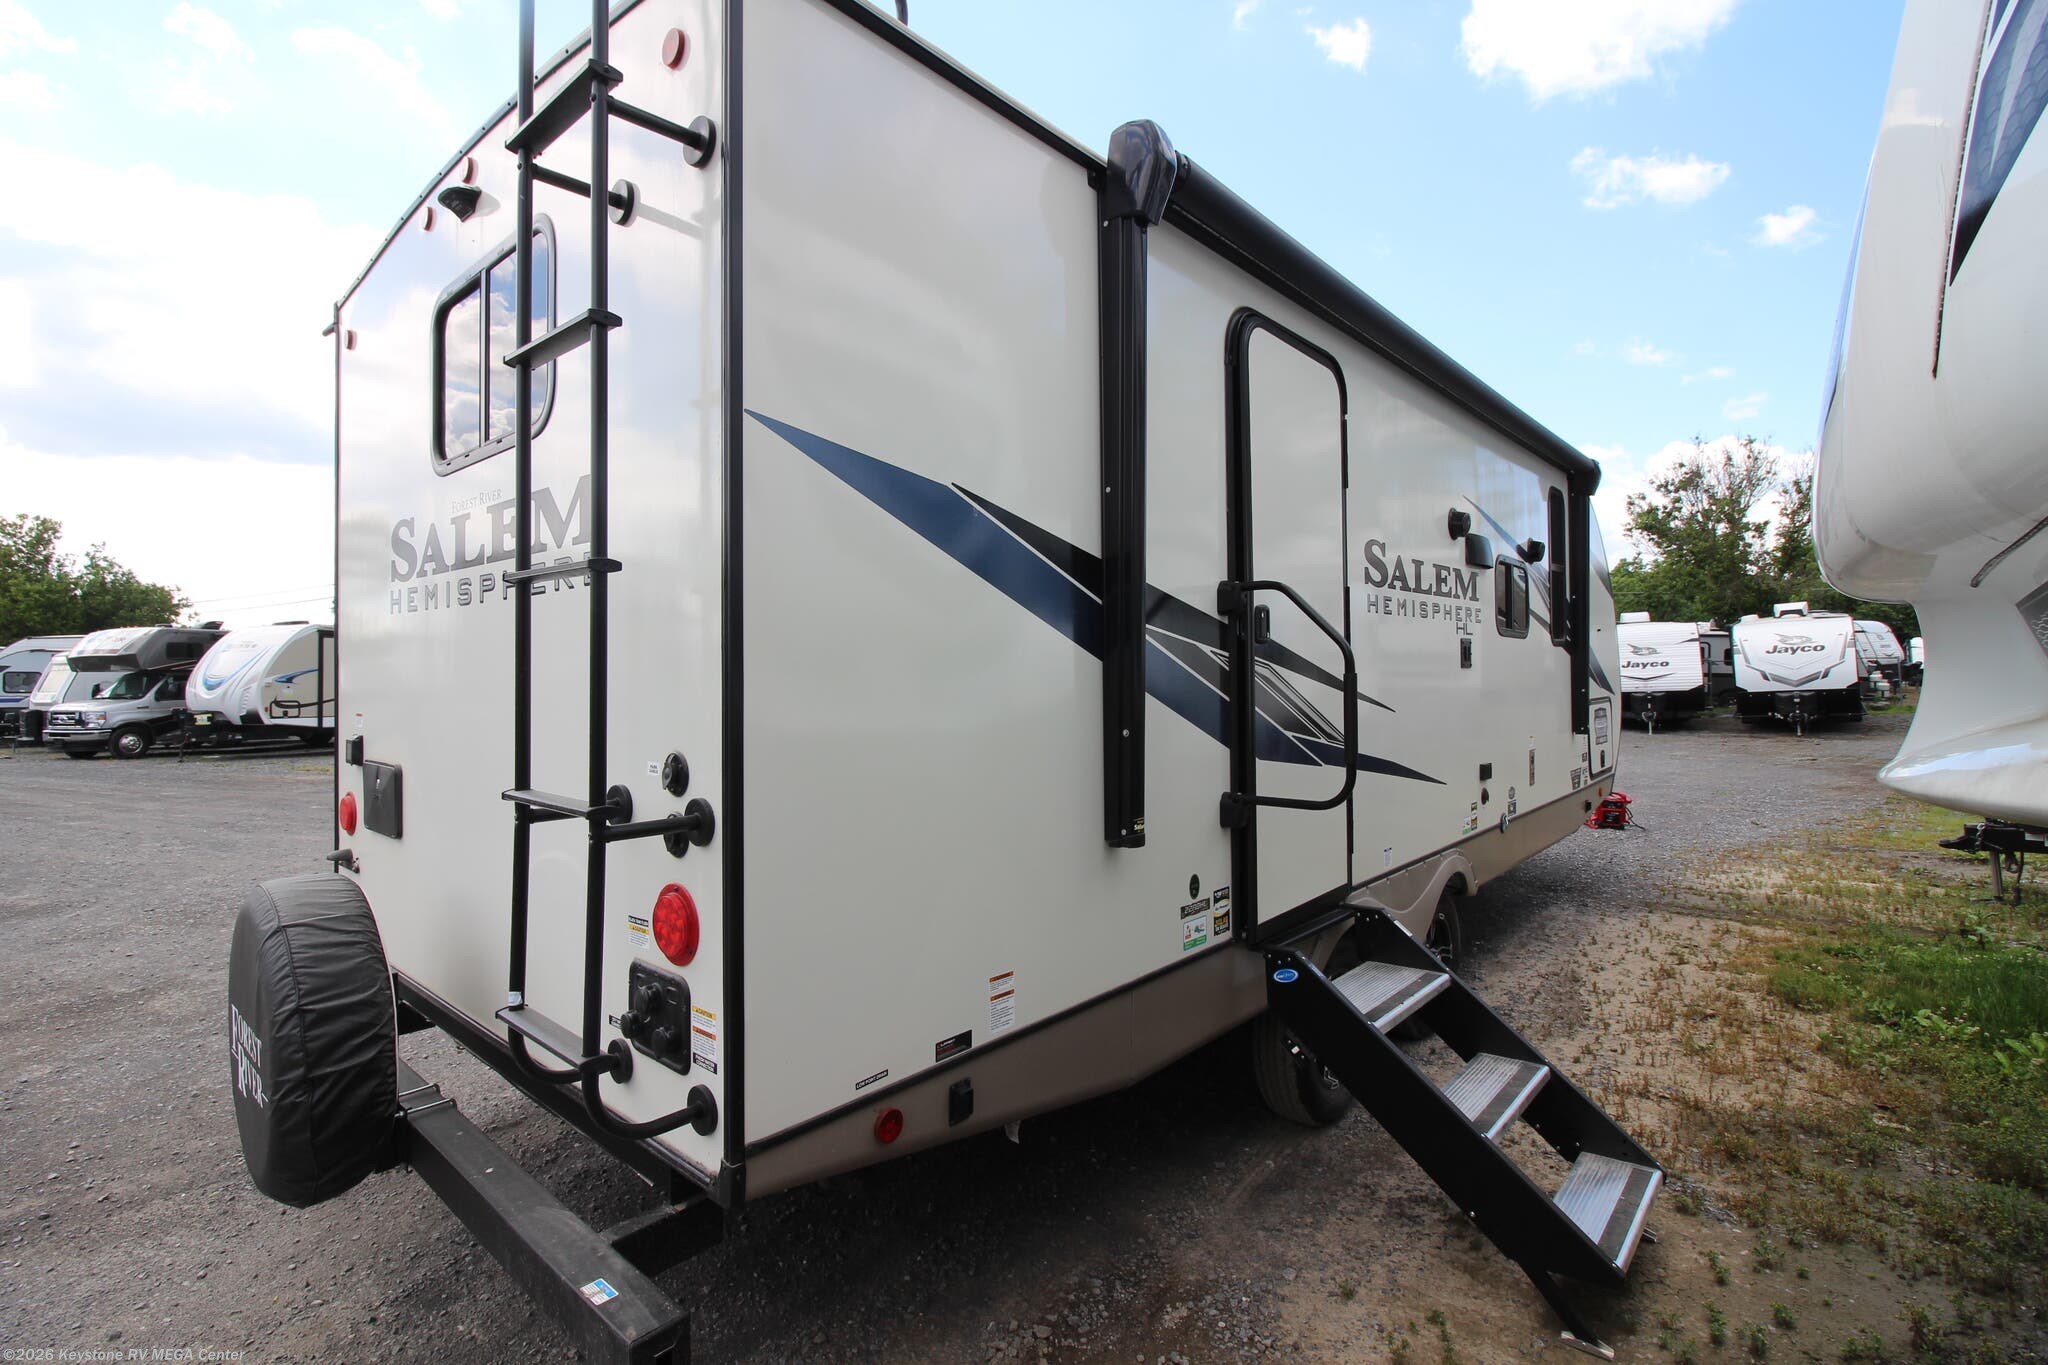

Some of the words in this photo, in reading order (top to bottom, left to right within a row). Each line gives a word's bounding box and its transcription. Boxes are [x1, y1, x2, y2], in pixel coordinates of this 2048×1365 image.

[391, 474, 592, 583] SALEM
[1364, 538, 1480, 602] SALEM
[1366, 593, 1482, 624] HEMISPHERE
[1455, 621, 1474, 636] HL
[1765, 643, 1826, 655] Jayco
[1621, 660, 1670, 669] Jayco
